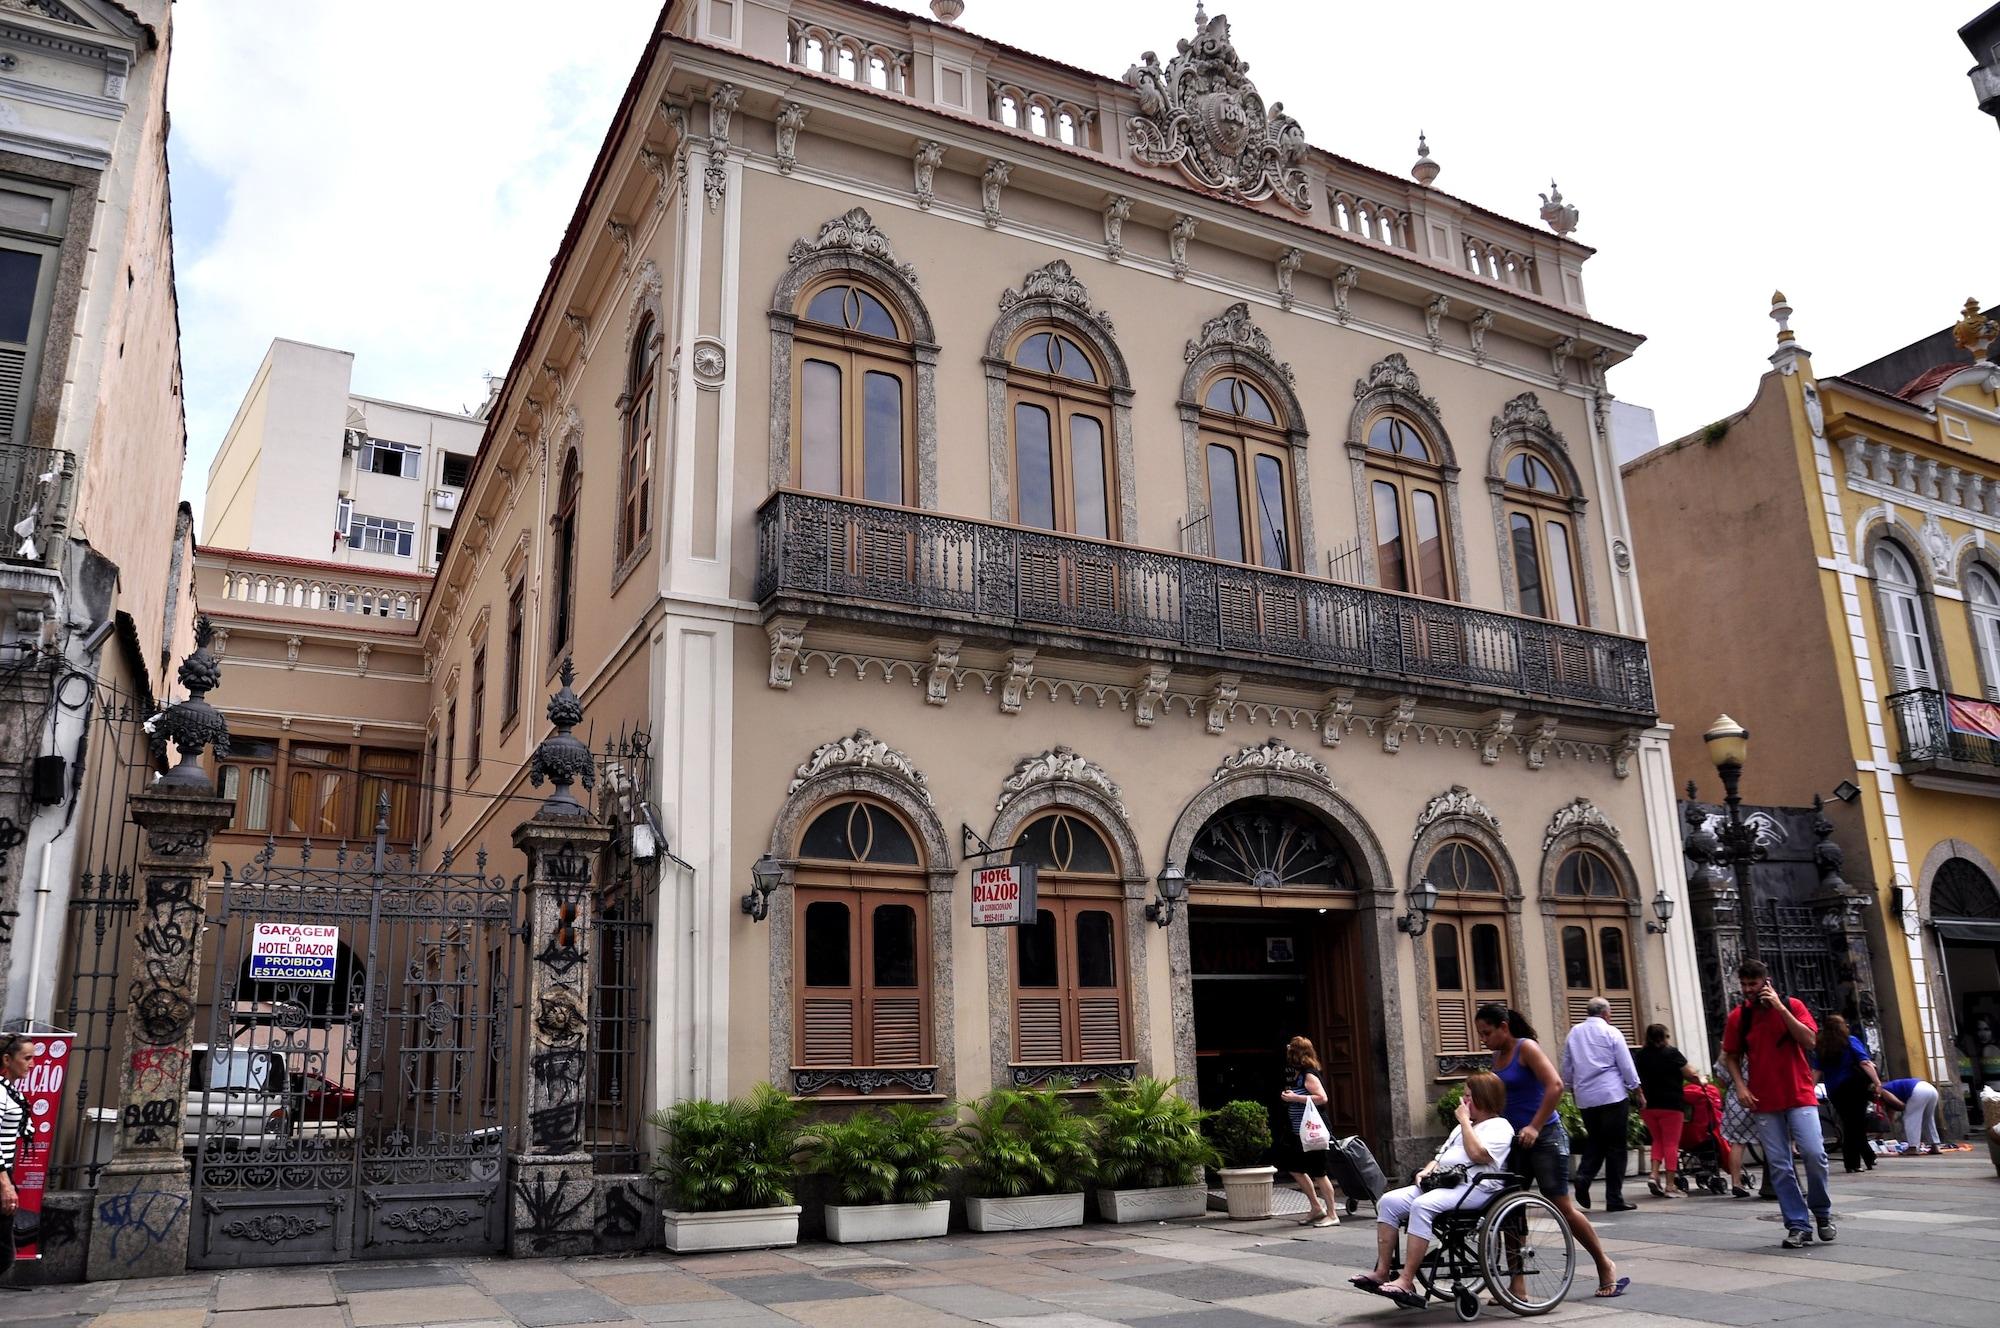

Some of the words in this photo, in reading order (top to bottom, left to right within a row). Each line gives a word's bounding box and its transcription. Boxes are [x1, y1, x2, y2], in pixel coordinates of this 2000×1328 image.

[980, 868, 1011, 884] HOTEL
[974, 883, 1018, 903] RIAZOR
[259, 925, 335, 937] GARAGEM
[258, 942, 292, 954] HOTEL
[295, 944, 333, 956] RIAZOR
[265, 957, 323, 967] PROIBIDO
[254, 968, 332, 978] ESTACIONAR
